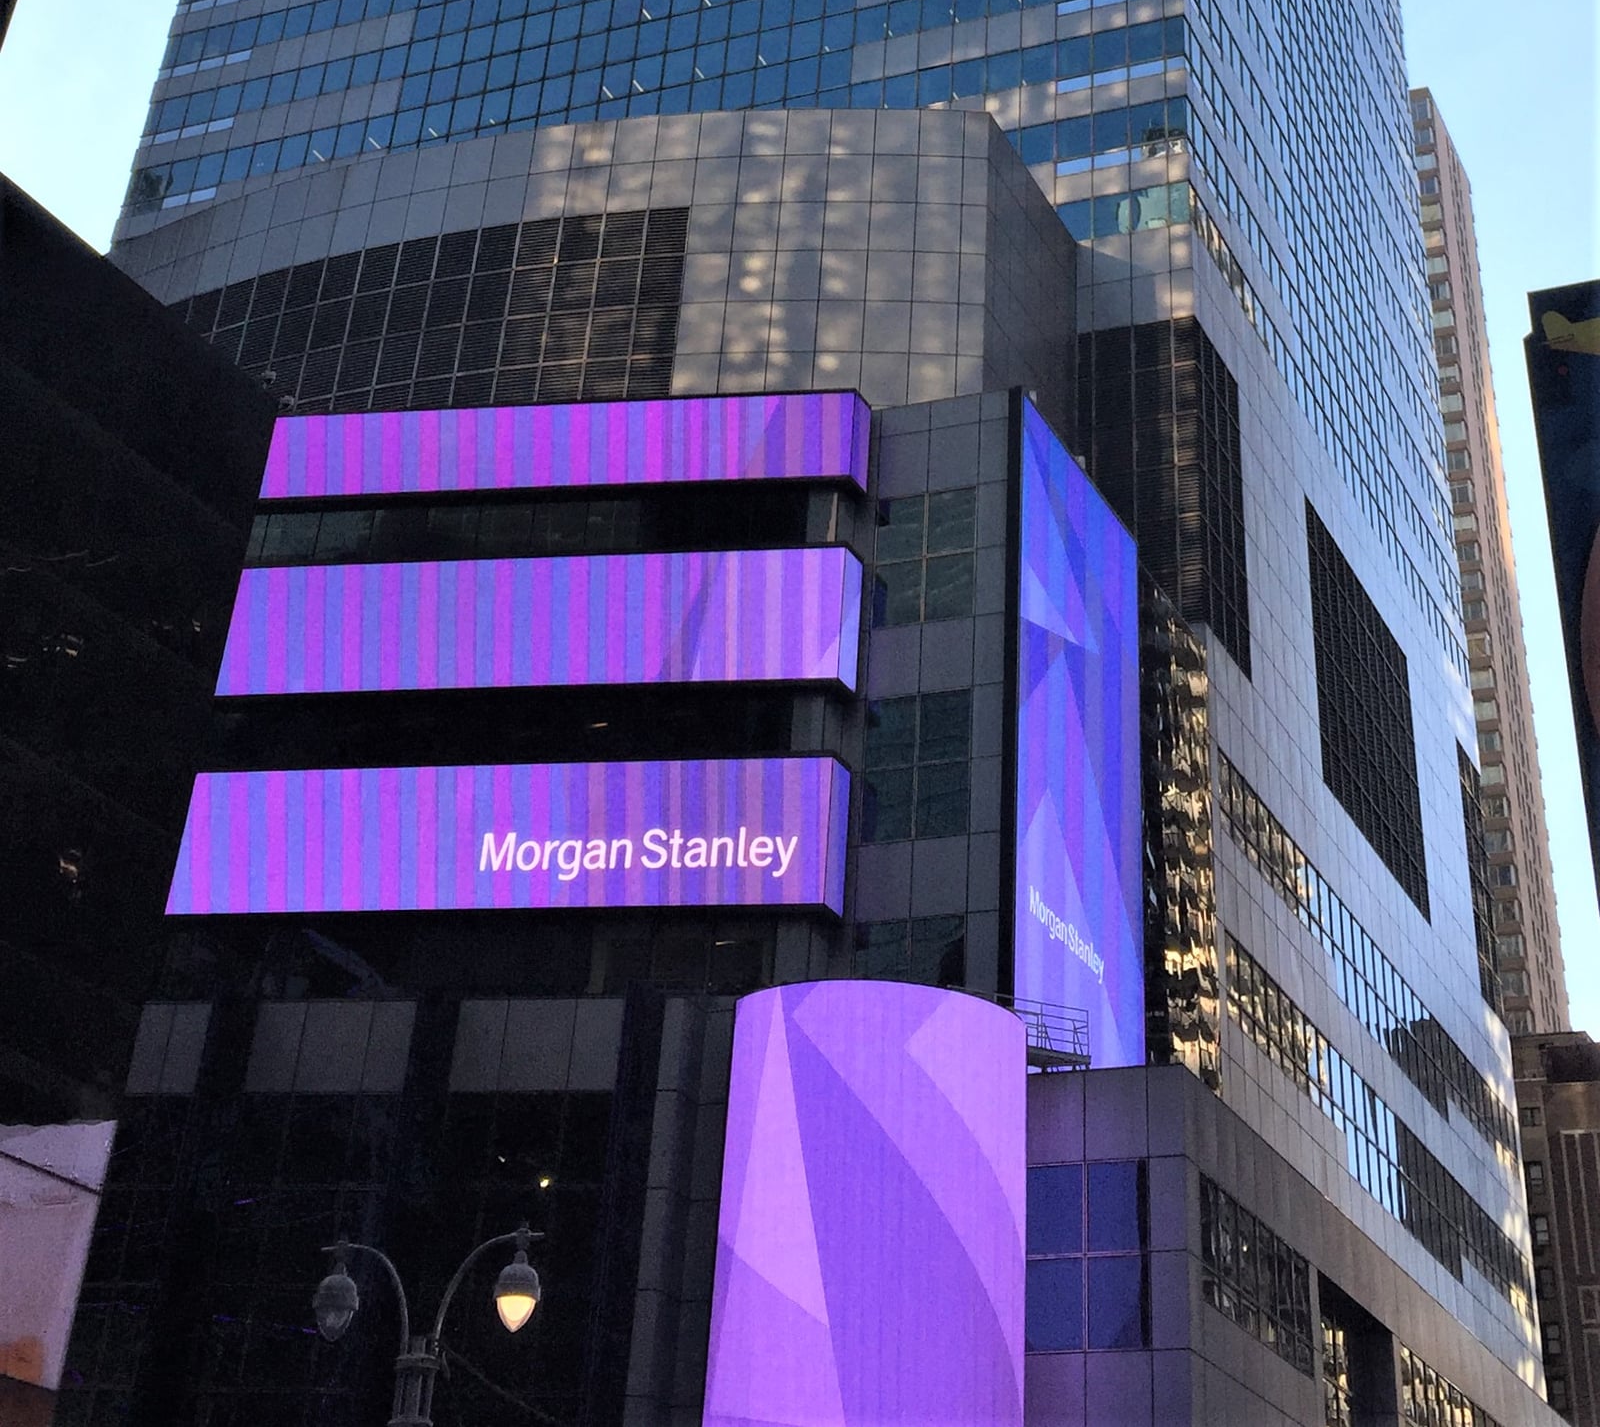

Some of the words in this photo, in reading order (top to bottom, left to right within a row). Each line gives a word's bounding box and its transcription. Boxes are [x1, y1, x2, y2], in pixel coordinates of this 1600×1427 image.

[479, 832, 631, 880] Morgan
[640, 827, 798, 877] Stanley
[1029, 885, 1068, 945] Morgan
[1068, 923, 1105, 984] Stanley
